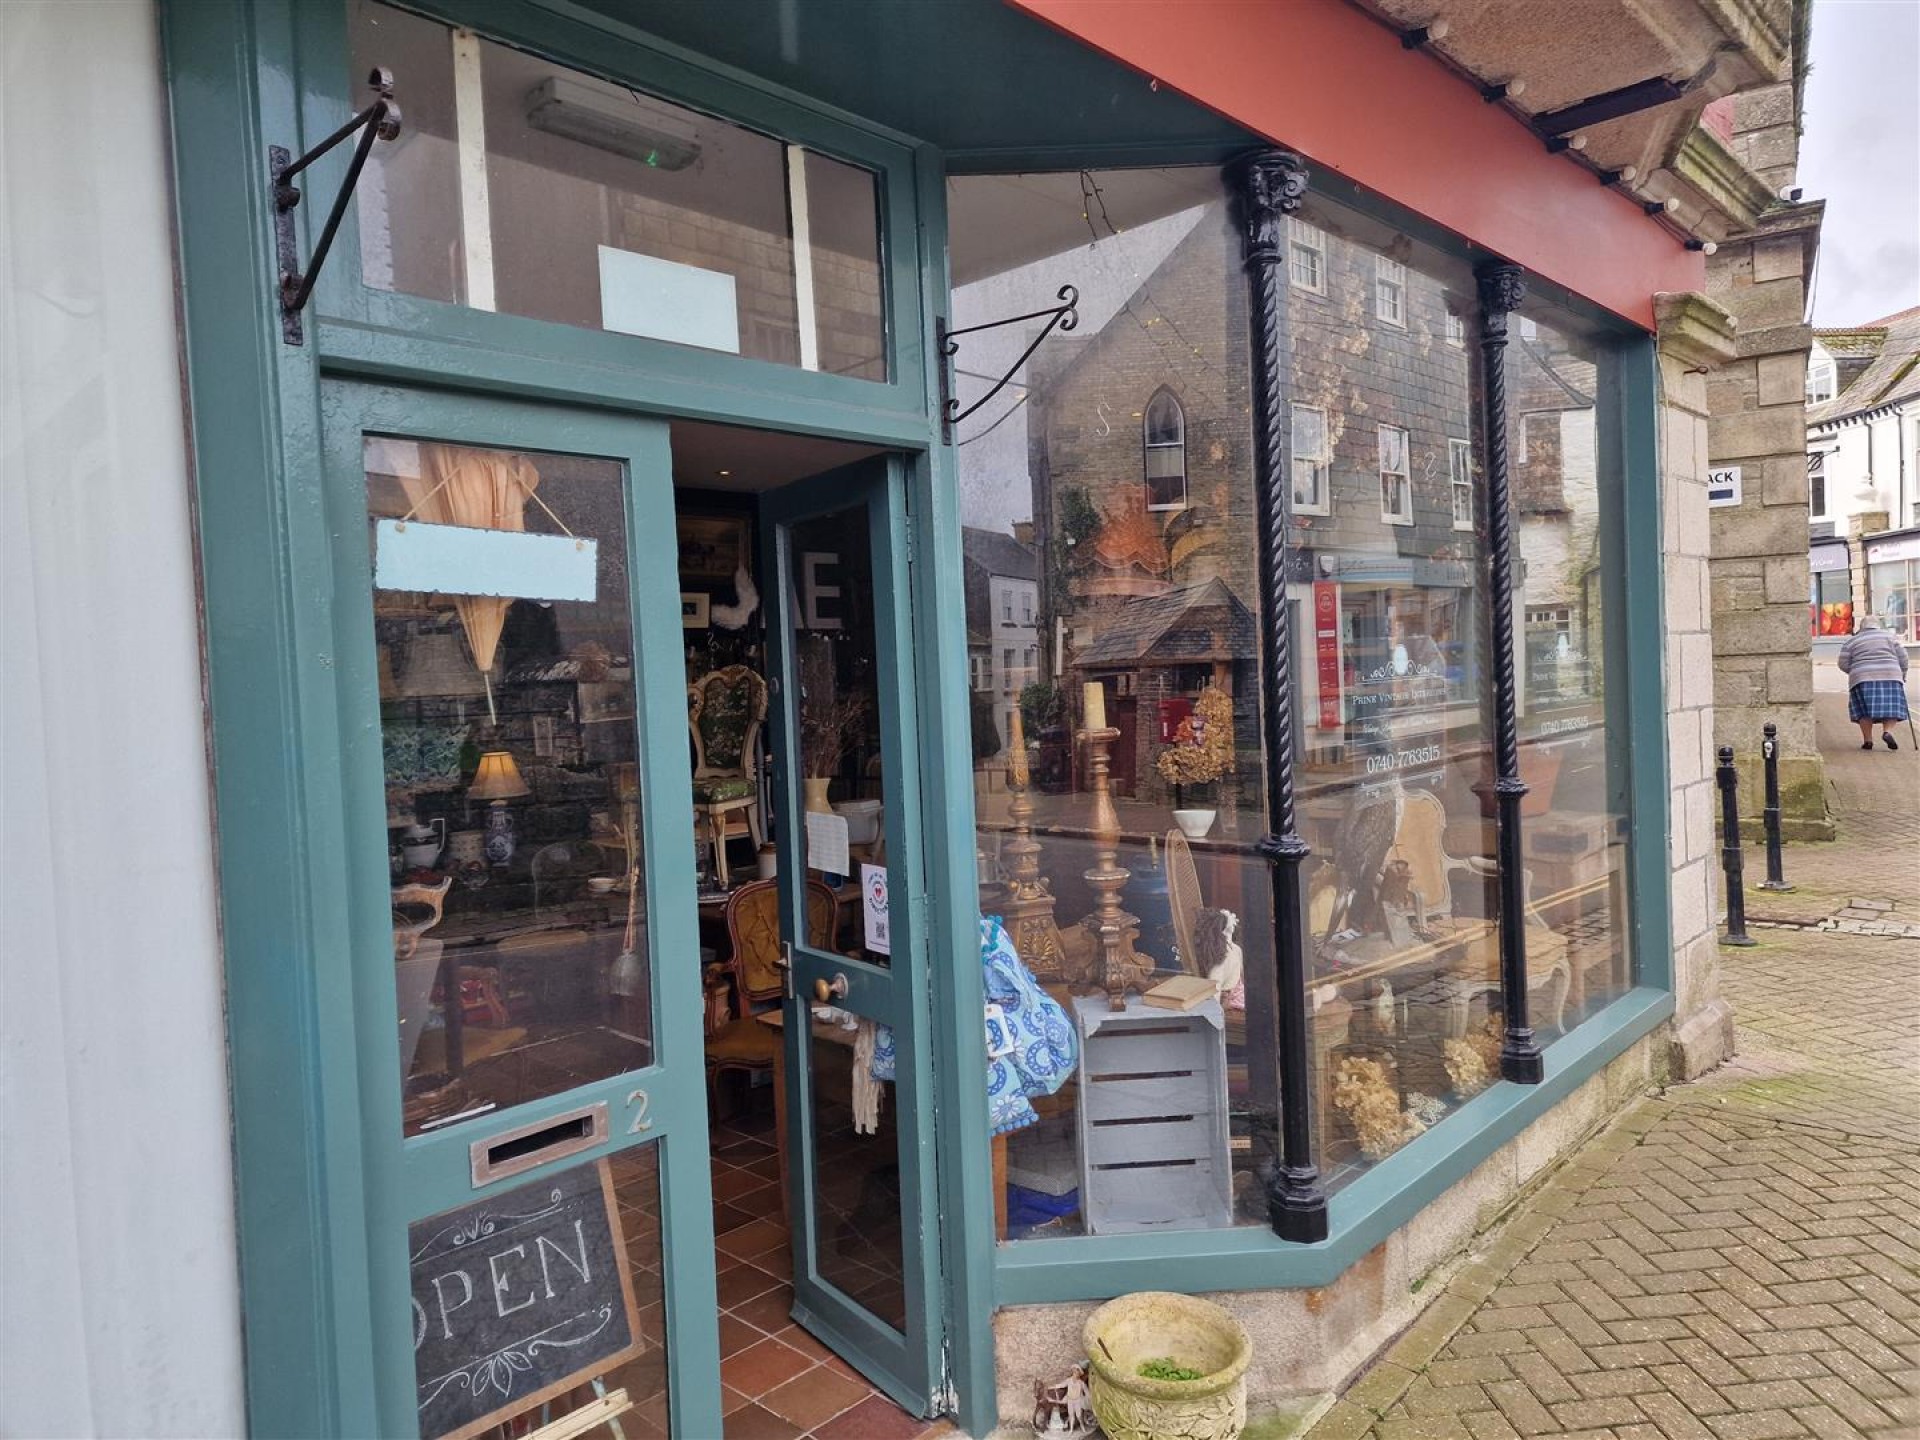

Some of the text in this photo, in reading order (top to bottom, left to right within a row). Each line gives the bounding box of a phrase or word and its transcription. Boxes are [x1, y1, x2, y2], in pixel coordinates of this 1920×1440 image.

[1352, 694, 1377, 705] PRINK
[1366, 752, 1394, 774] 0740
[625, 1089, 652, 1135] 2
